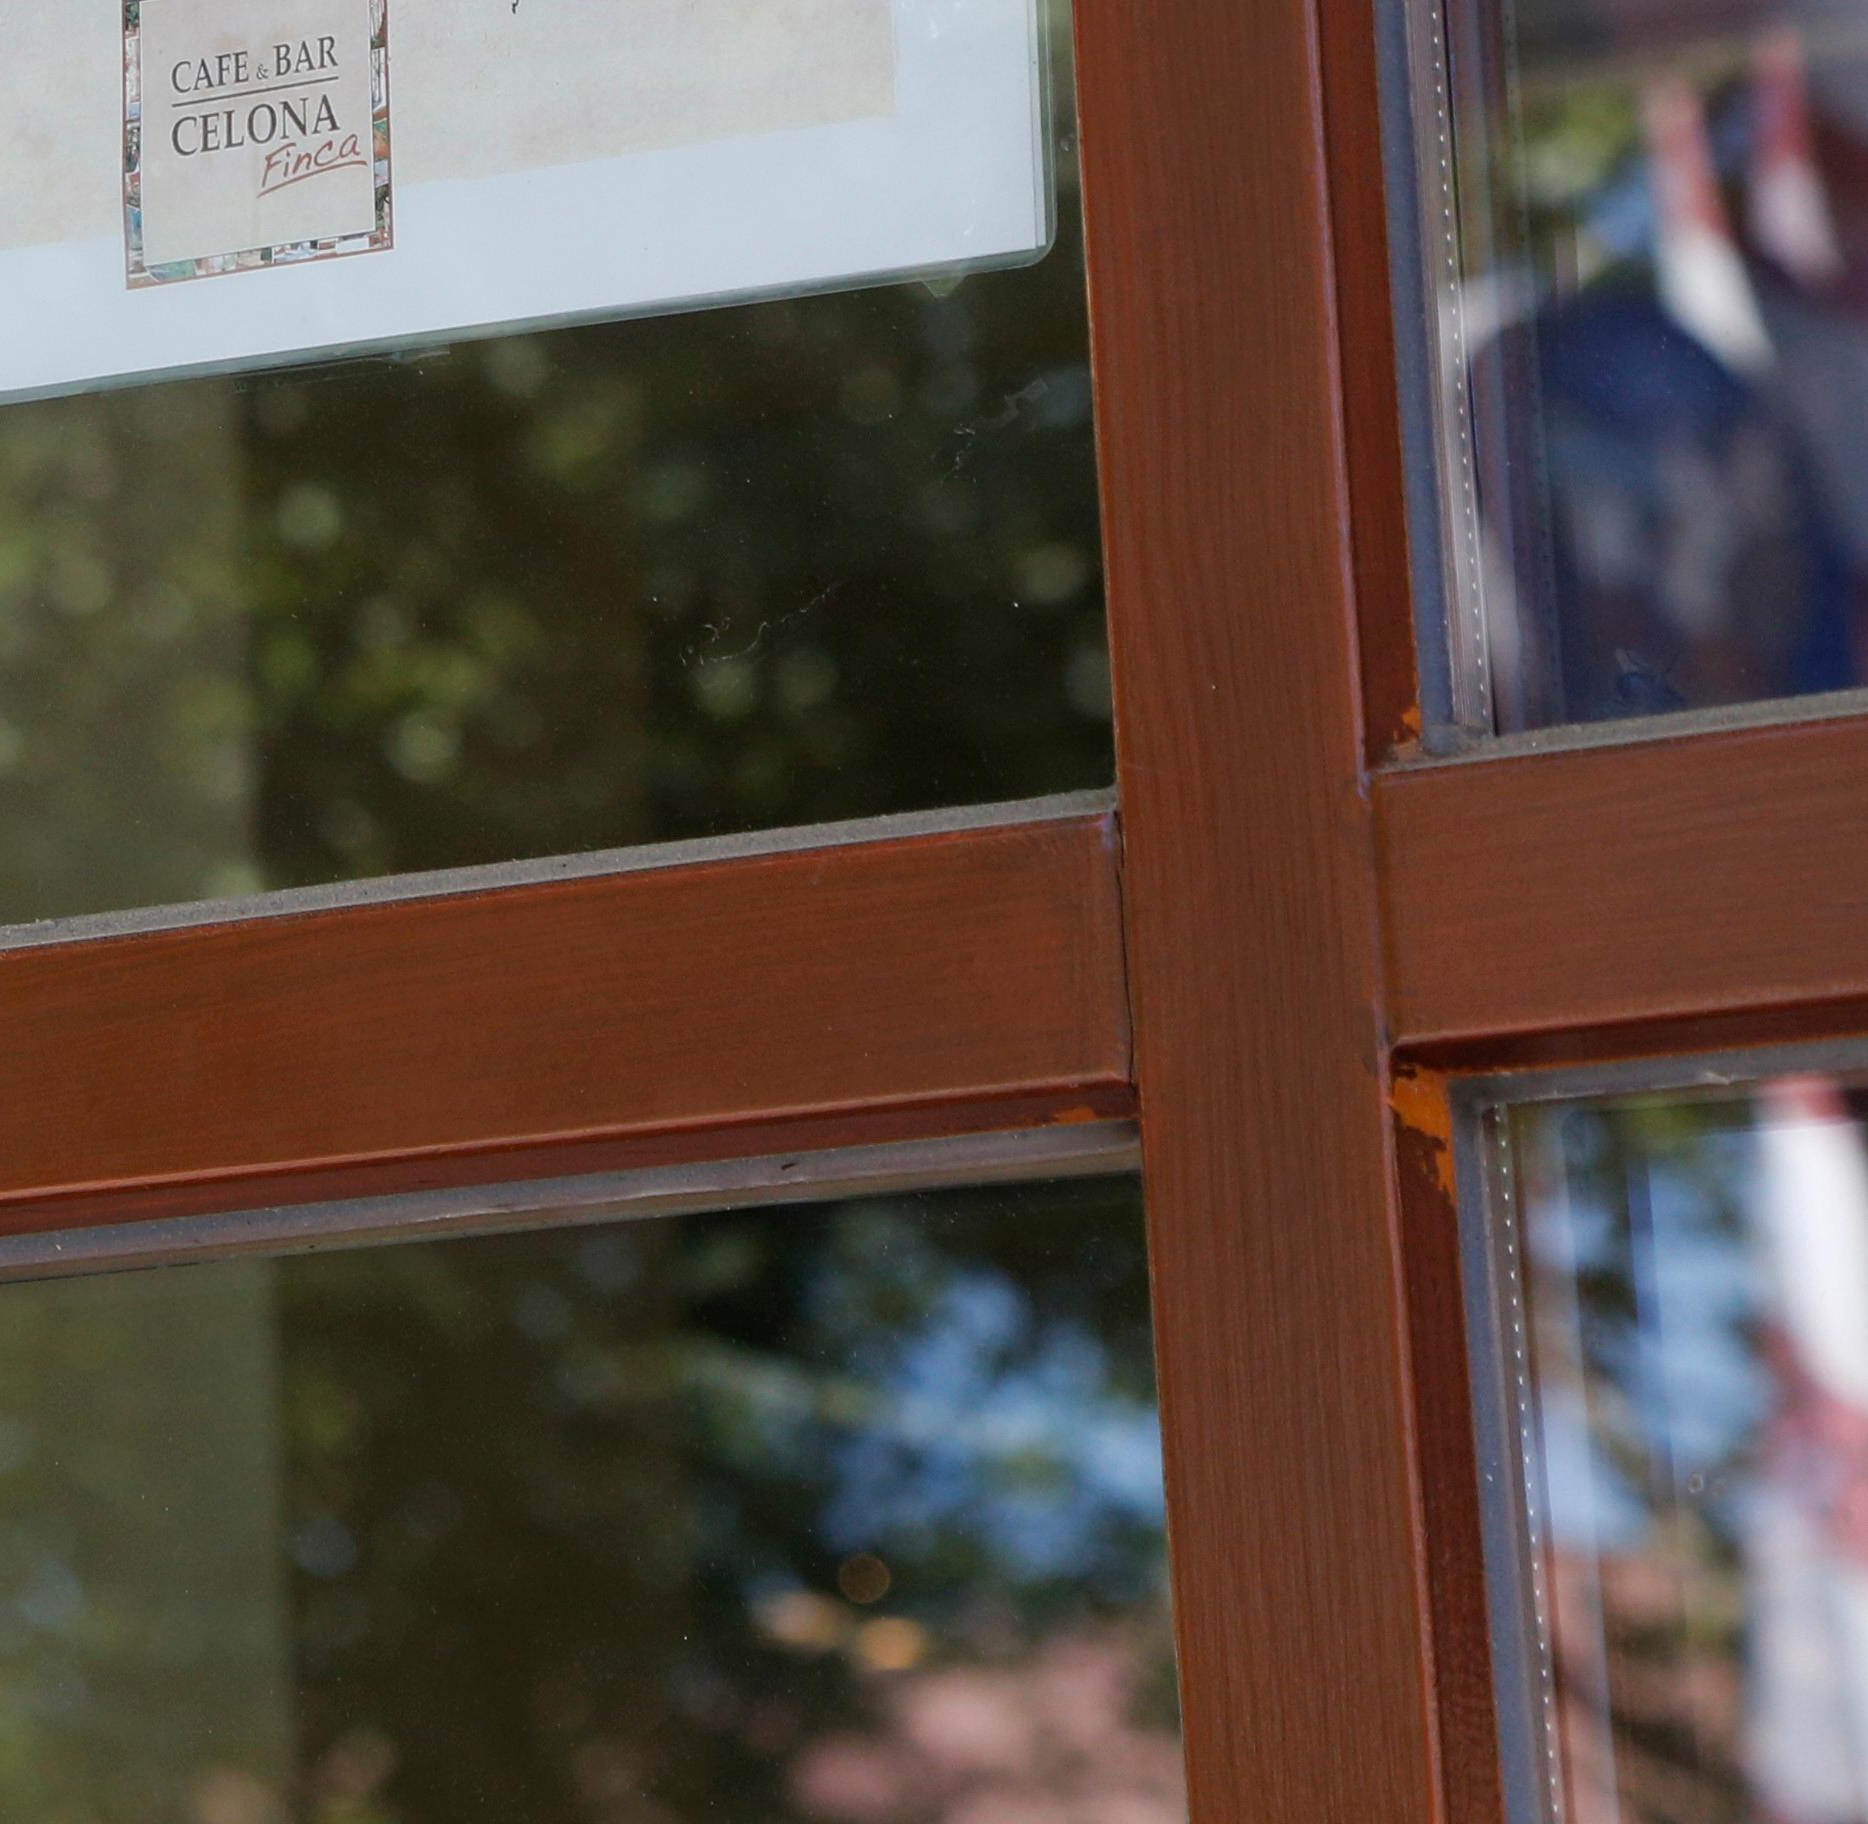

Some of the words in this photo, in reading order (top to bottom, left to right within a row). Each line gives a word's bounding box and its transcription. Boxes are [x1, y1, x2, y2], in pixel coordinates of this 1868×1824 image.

[170, 50, 250, 94] CAFE
[256, 62, 269, 80] &
[273, 35, 339, 77] BAR
[170, 93, 341, 157] CELONA
[261, 133, 361, 189] Finca
